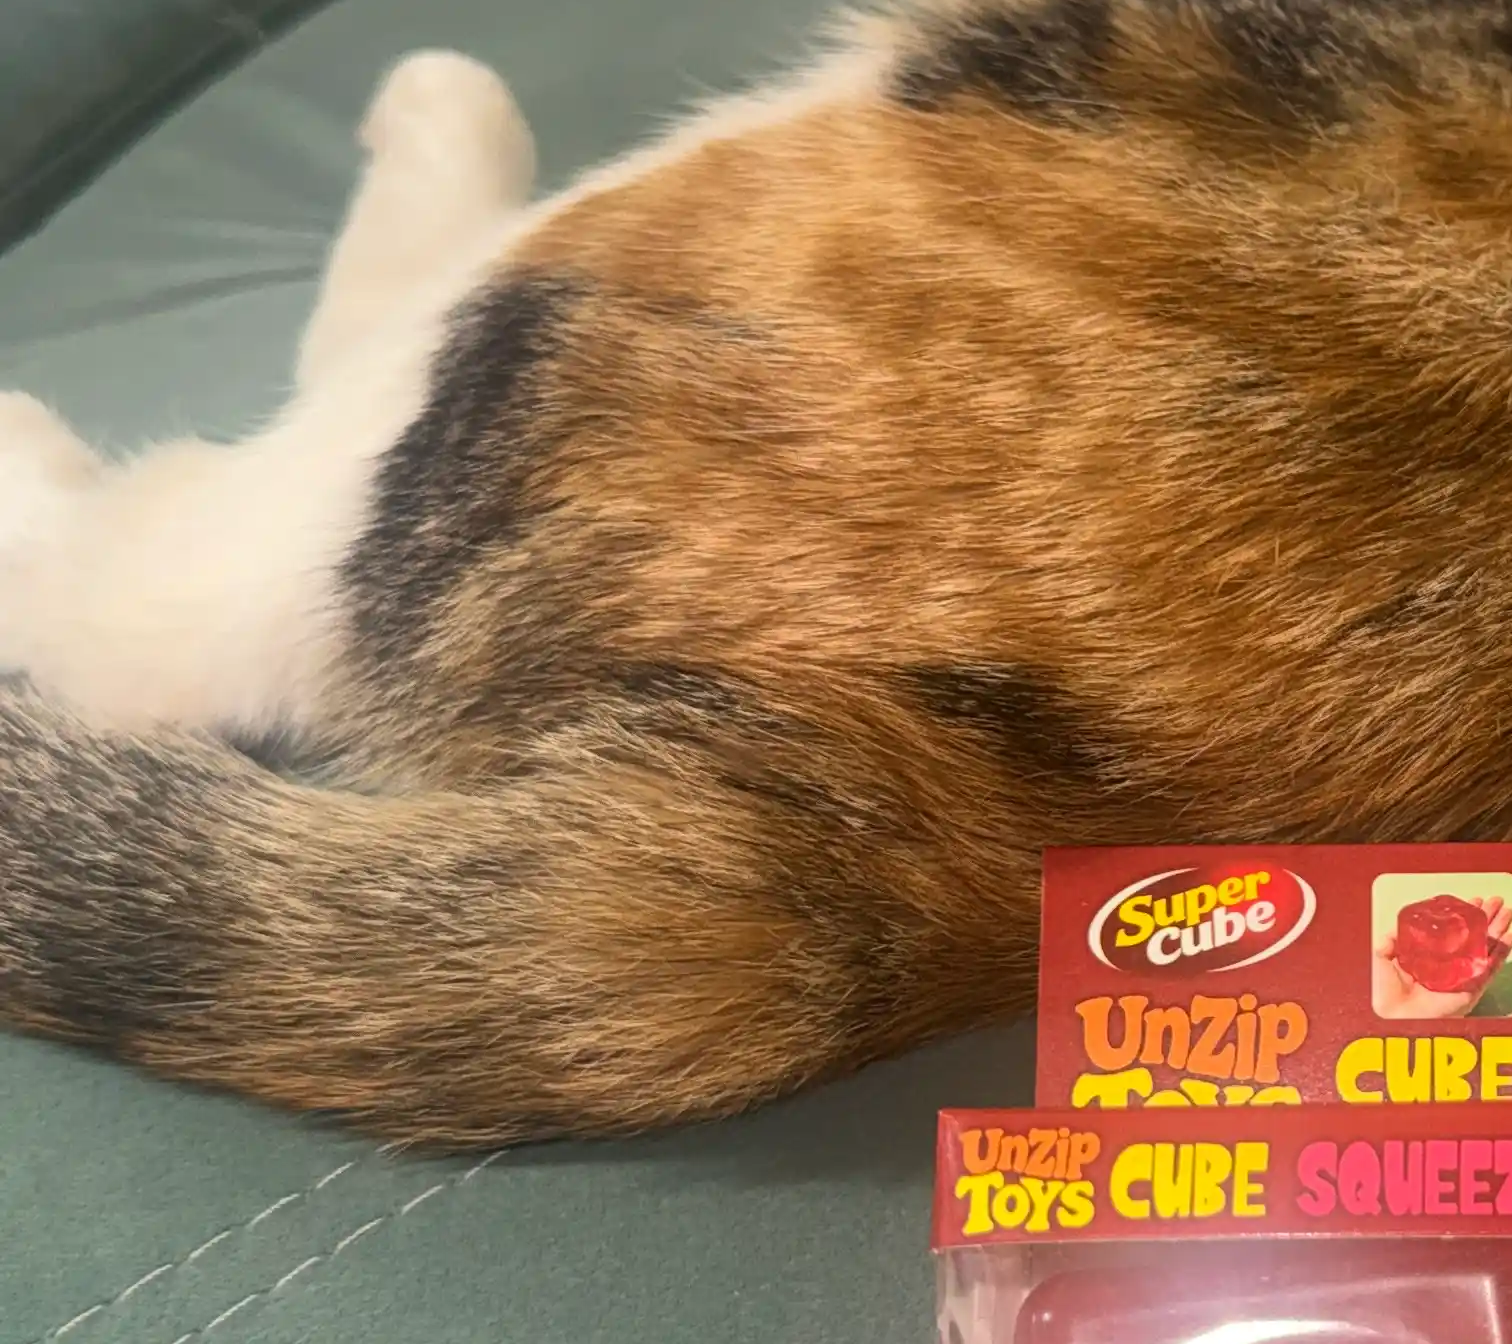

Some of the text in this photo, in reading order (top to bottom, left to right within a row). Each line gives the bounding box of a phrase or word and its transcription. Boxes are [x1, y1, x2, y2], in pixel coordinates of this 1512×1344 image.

[1115, 871, 1271, 948] Super
[1146, 901, 1276, 966] Cube
[1110, 1142, 1269, 1220] CUBE
